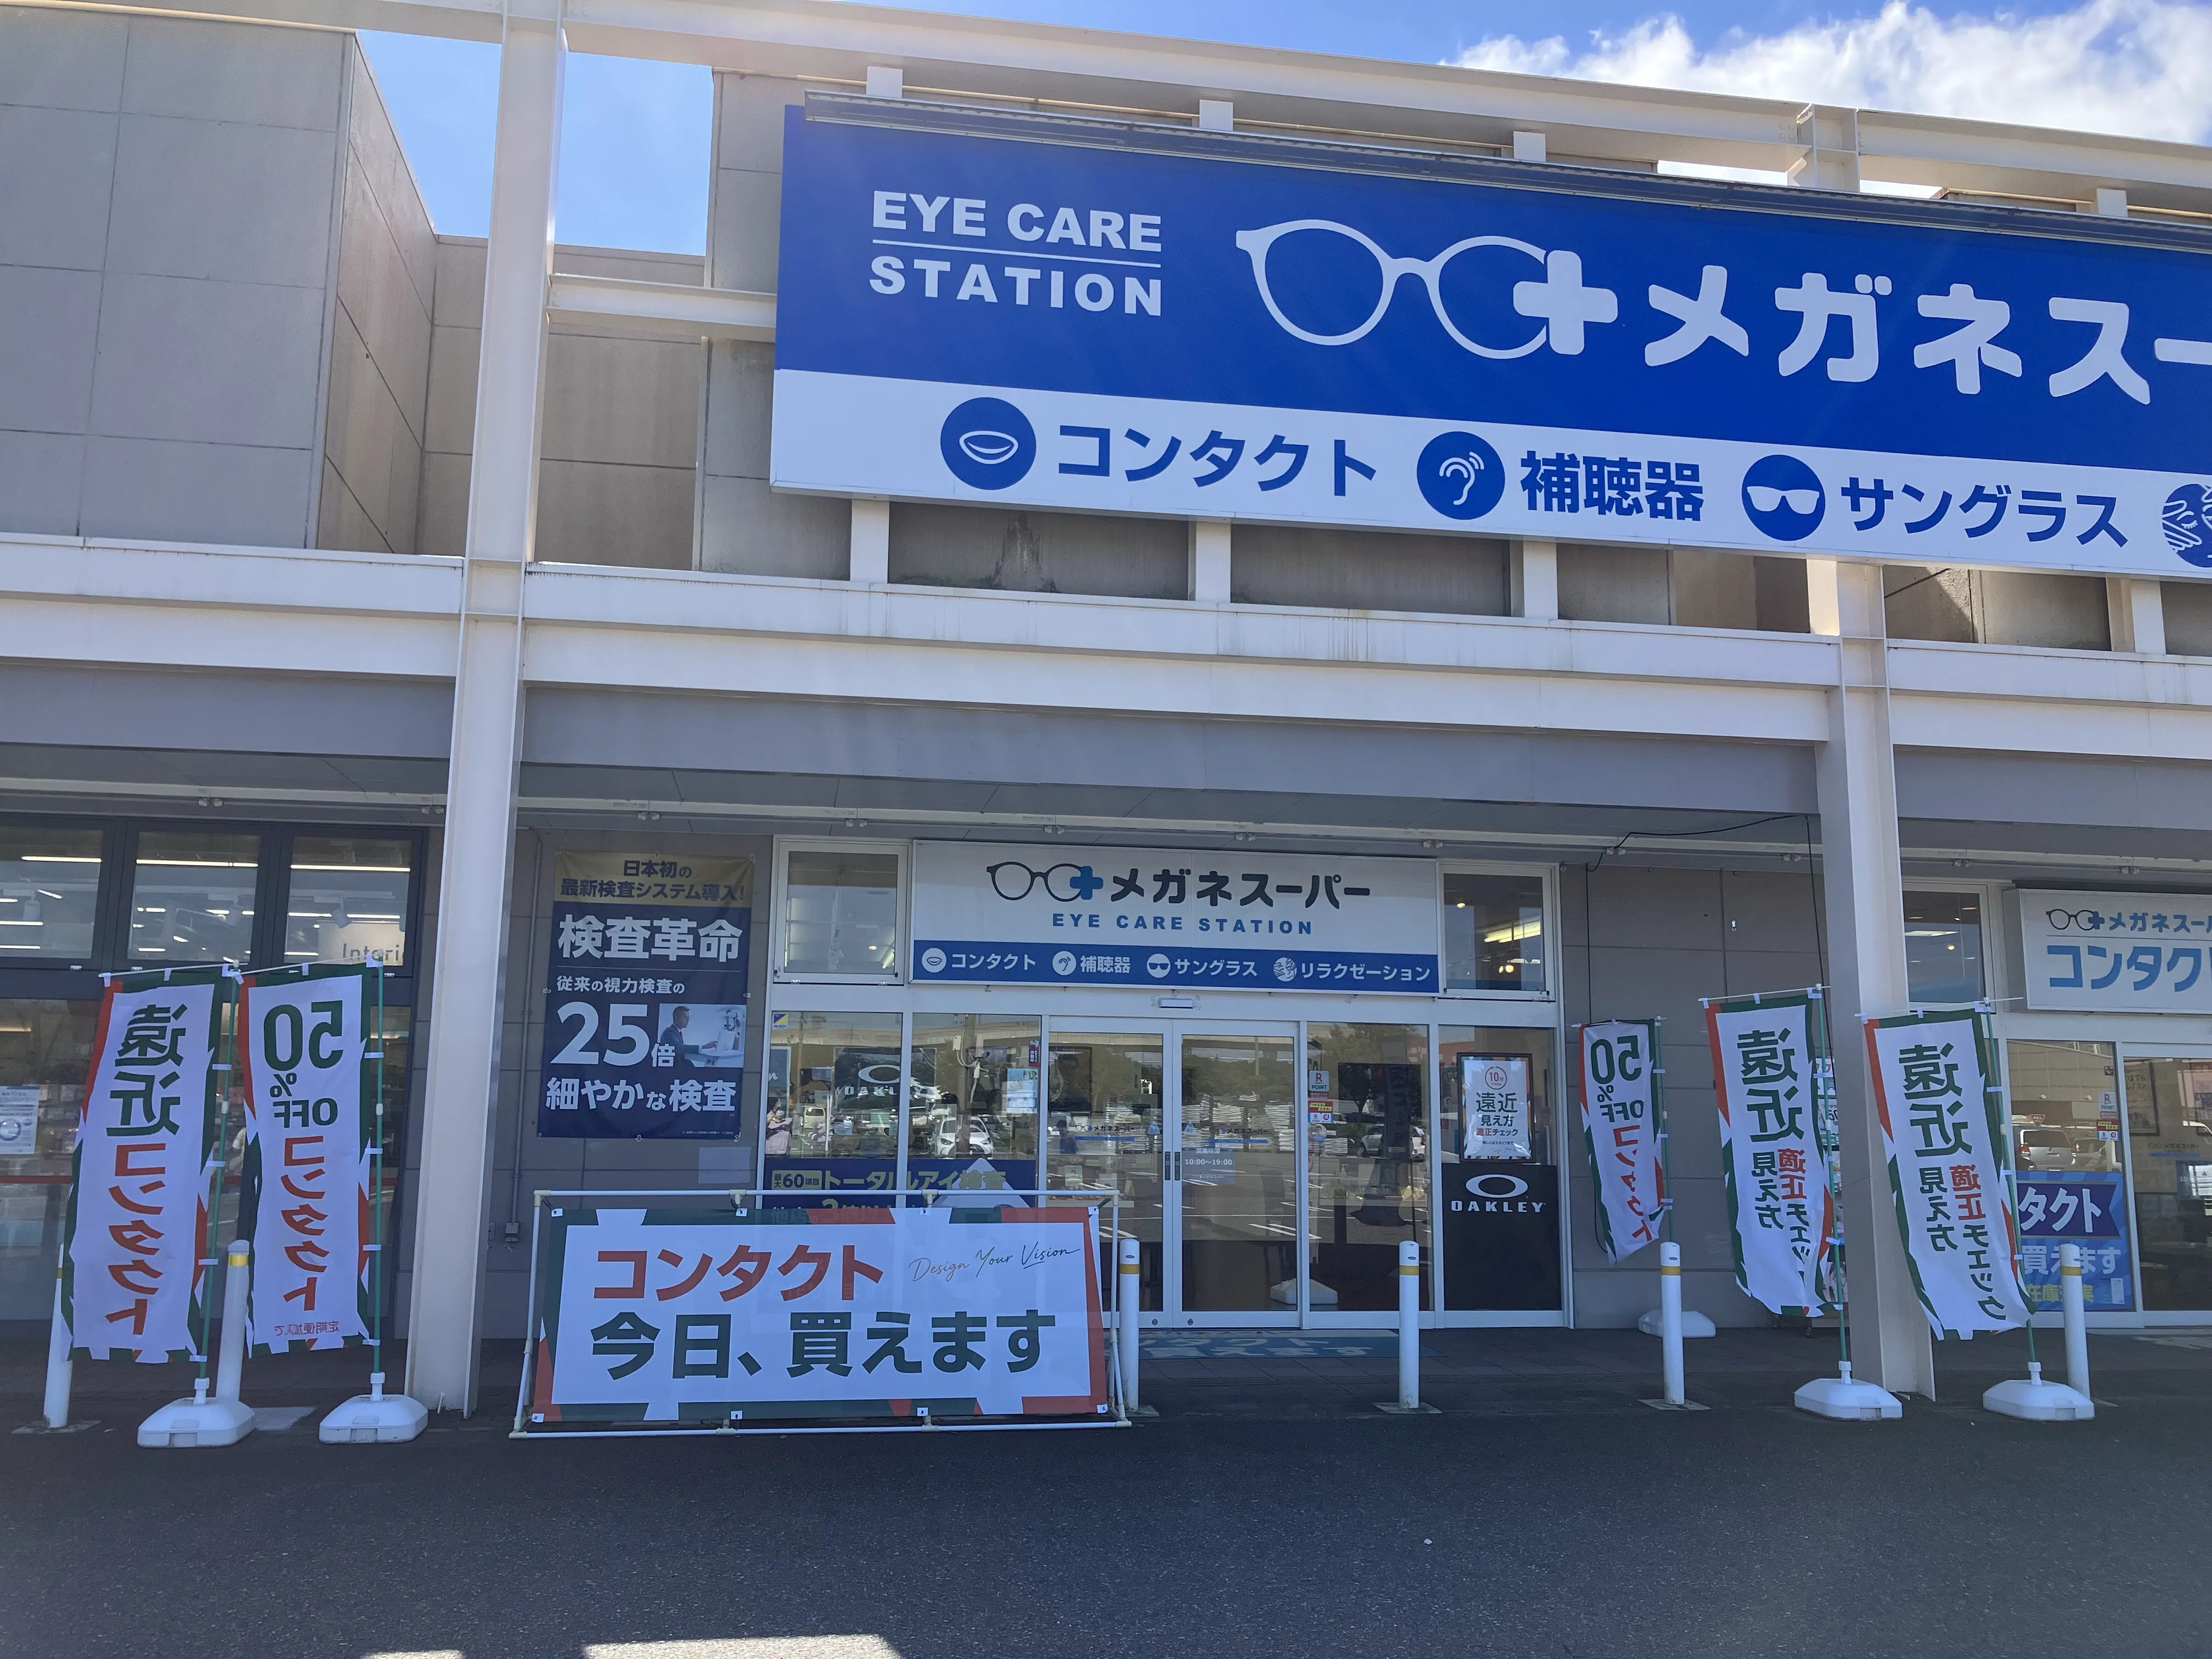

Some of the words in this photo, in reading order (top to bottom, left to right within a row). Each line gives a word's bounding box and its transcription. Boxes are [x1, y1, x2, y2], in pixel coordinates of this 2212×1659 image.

[872, 190, 986, 236] EYE
[1007, 203, 1161, 252] CARE
[870, 255, 1161, 317] STATION
[1645, 265, 2212, 405] メガネスー
[1058, 425, 1377, 498] コンタクト
[1521, 450, 1703, 522] 補聴器
[1839, 477, 2129, 549] サングラス
[623, 860, 692, 878] 日本初の
[1111, 867, 1371, 910] メガネスーパー
[560, 878, 745, 901] 最新検査システム導入!
[558, 913, 743, 962] 検査革命
[1052, 913, 1101, 928] EYE
[1116, 915, 1184, 932] CARE
[1199, 918, 1313, 935] STATION
[951, 952, 1037, 971] コンタクト
[1080, 955, 1131, 974] 補聴器
[1175, 958, 1258, 978] サングラス
[1301, 961, 1431, 981] リラクゼーション
[2046, 945, 2212, 992] コンタク
[556, 975, 685, 994] 従来の視力検査の
[546, 1076, 737, 1113] 細やかな検査
[1476, 1092, 1518, 1113] 遠近
[1476, 1128, 1519, 1136] 適正チェック
[1481, 1115, 1514, 1126] 見え方
[1451, 1200, 1544, 1213] OAKLEY
[2018, 1186, 2102, 1233] タクト
[593, 1244, 884, 1302] コンタクト
[909, 1257, 970, 1282] Design
[975, 1246, 1014, 1278] Your
[1021, 1241, 1081, 1269] Vision
[590, 1309, 1056, 1381] 今日、買えます
